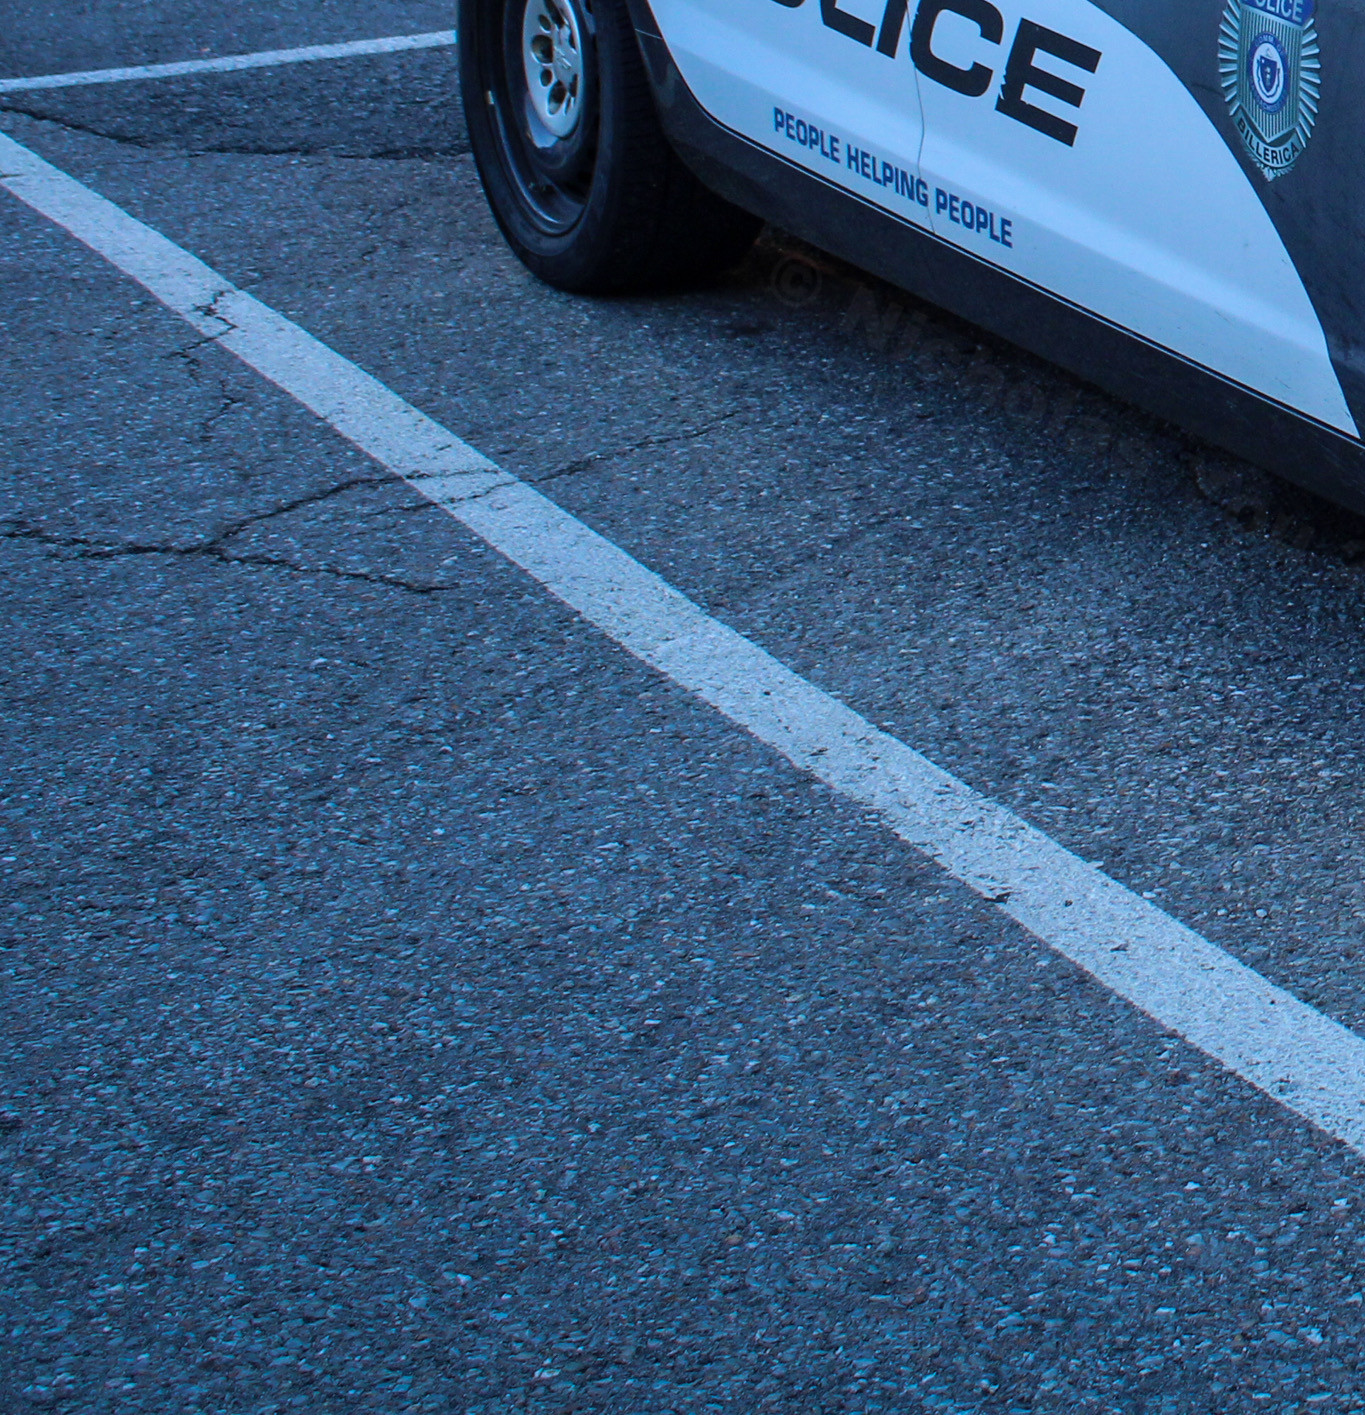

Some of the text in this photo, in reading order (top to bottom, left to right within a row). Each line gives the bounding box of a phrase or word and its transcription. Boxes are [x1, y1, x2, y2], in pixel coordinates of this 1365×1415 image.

[773, 107, 1014, 249] PEOPLE HELPING PEOPLE
[1236, 117, 1301, 165] BILLERICA
